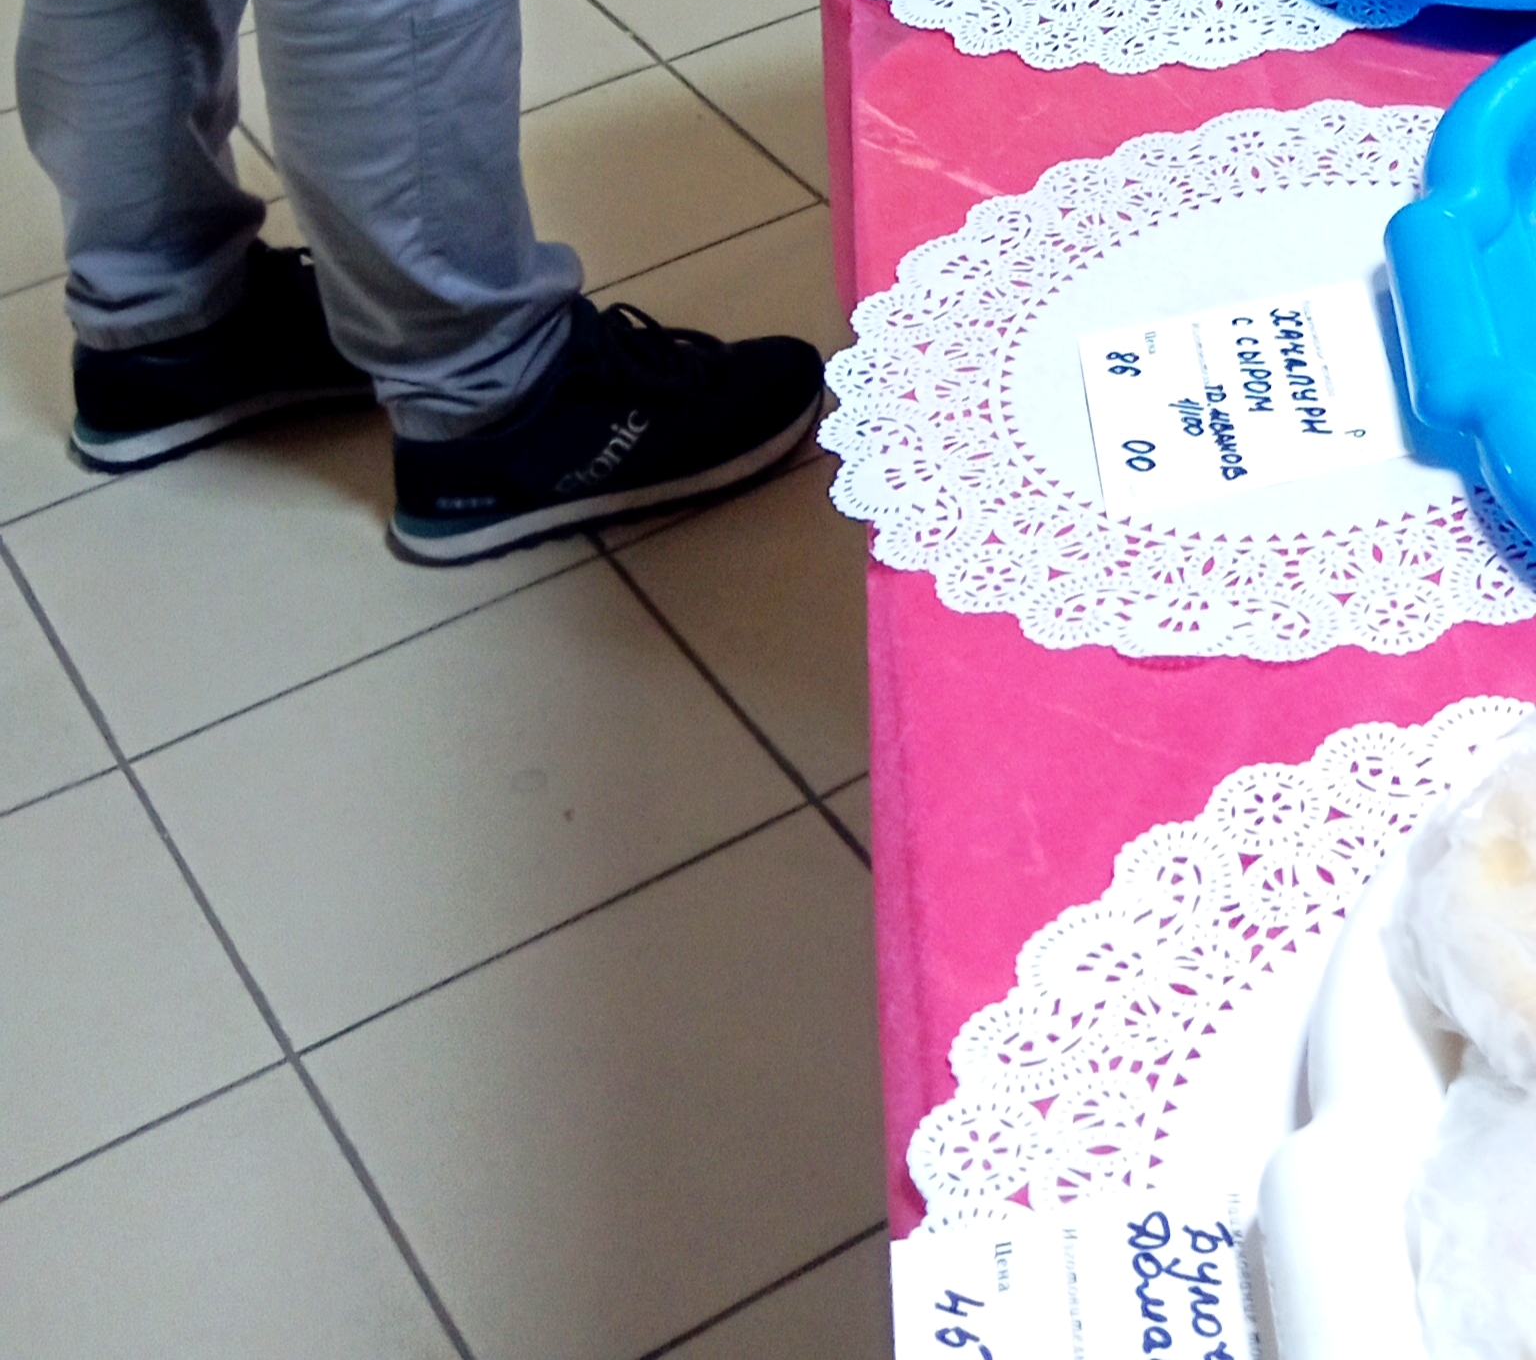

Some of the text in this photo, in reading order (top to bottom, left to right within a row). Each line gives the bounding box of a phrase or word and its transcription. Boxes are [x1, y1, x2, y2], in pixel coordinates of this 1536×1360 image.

[1106, 351, 1156, 472] 86 00
[1236, 337, 1274, 412] СЫРОМ
[994, 1241, 1012, 1292] Цена
[1127, 1211, 1172, 1360] Дома
